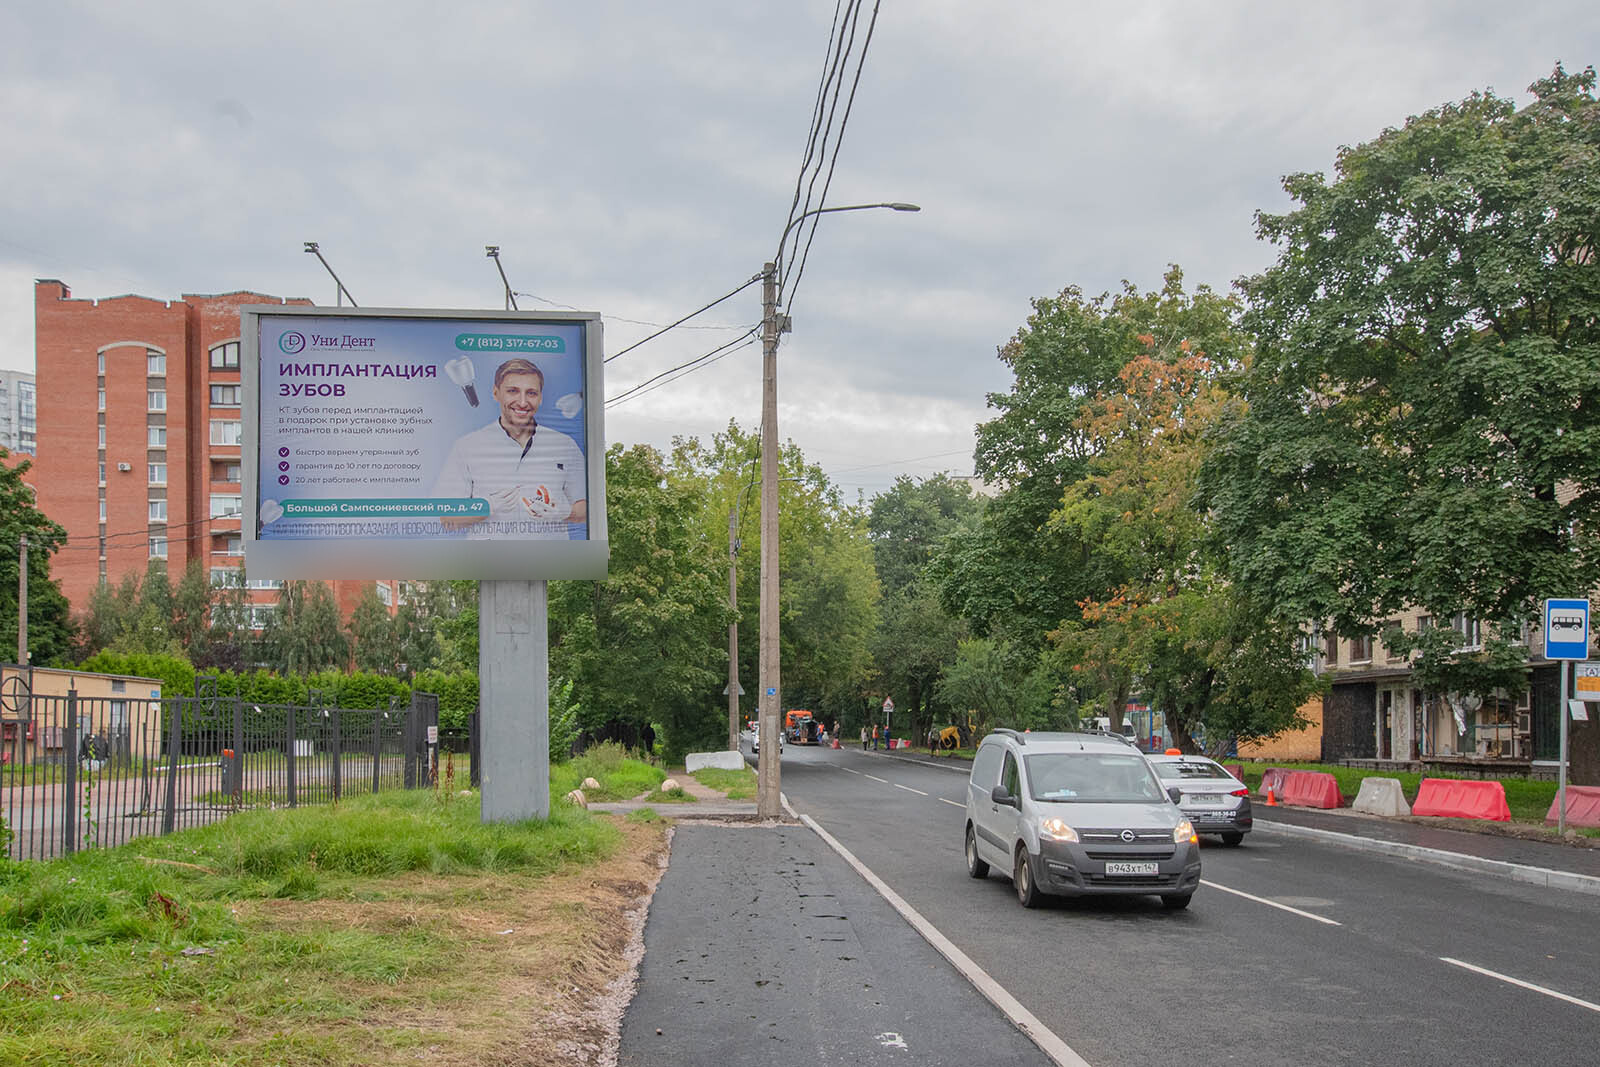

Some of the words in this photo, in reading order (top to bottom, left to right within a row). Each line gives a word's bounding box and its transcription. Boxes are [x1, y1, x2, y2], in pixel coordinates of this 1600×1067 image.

[311, 335, 338, 347] Уни
[341, 335, 376, 349] Дент
[461, 338, 474, 347] +7
[478, 337, 503, 349] (812)
[506, 338, 559, 349] 317-67-03
[279, 363, 437, 379] ИМПЛАНТАЦИЯ
[279, 383, 346, 397] ЗУБОВ
[278, 406, 290, 415] КТ
[293, 406, 320, 415] зубов
[322, 407, 352, 416] перед
[354, 406, 424, 416] имплантацией
[287, 417, 328, 426] подарок
[330, 417, 348, 426] при
[349, 417, 398, 426] установке
[399, 416, 433, 425] зубных
[279, 427, 331, 435] имплантов
[342, 426, 373, 435] нашей
[375, 427, 415, 435] клинике
[296, 448, 326, 457] быстро
[406, 448, 420, 456] зуб
[334, 463, 345, 471] до
[383, 463, 421, 471] договору
[322, 476, 361, 484] работаем
[287, 503, 338, 513] Большой
[340, 502, 434, 513] Сампсониевский
[437, 502, 456, 513] пр.,
[458, 503, 468, 512] д.
[471, 502, 483, 511] 47
